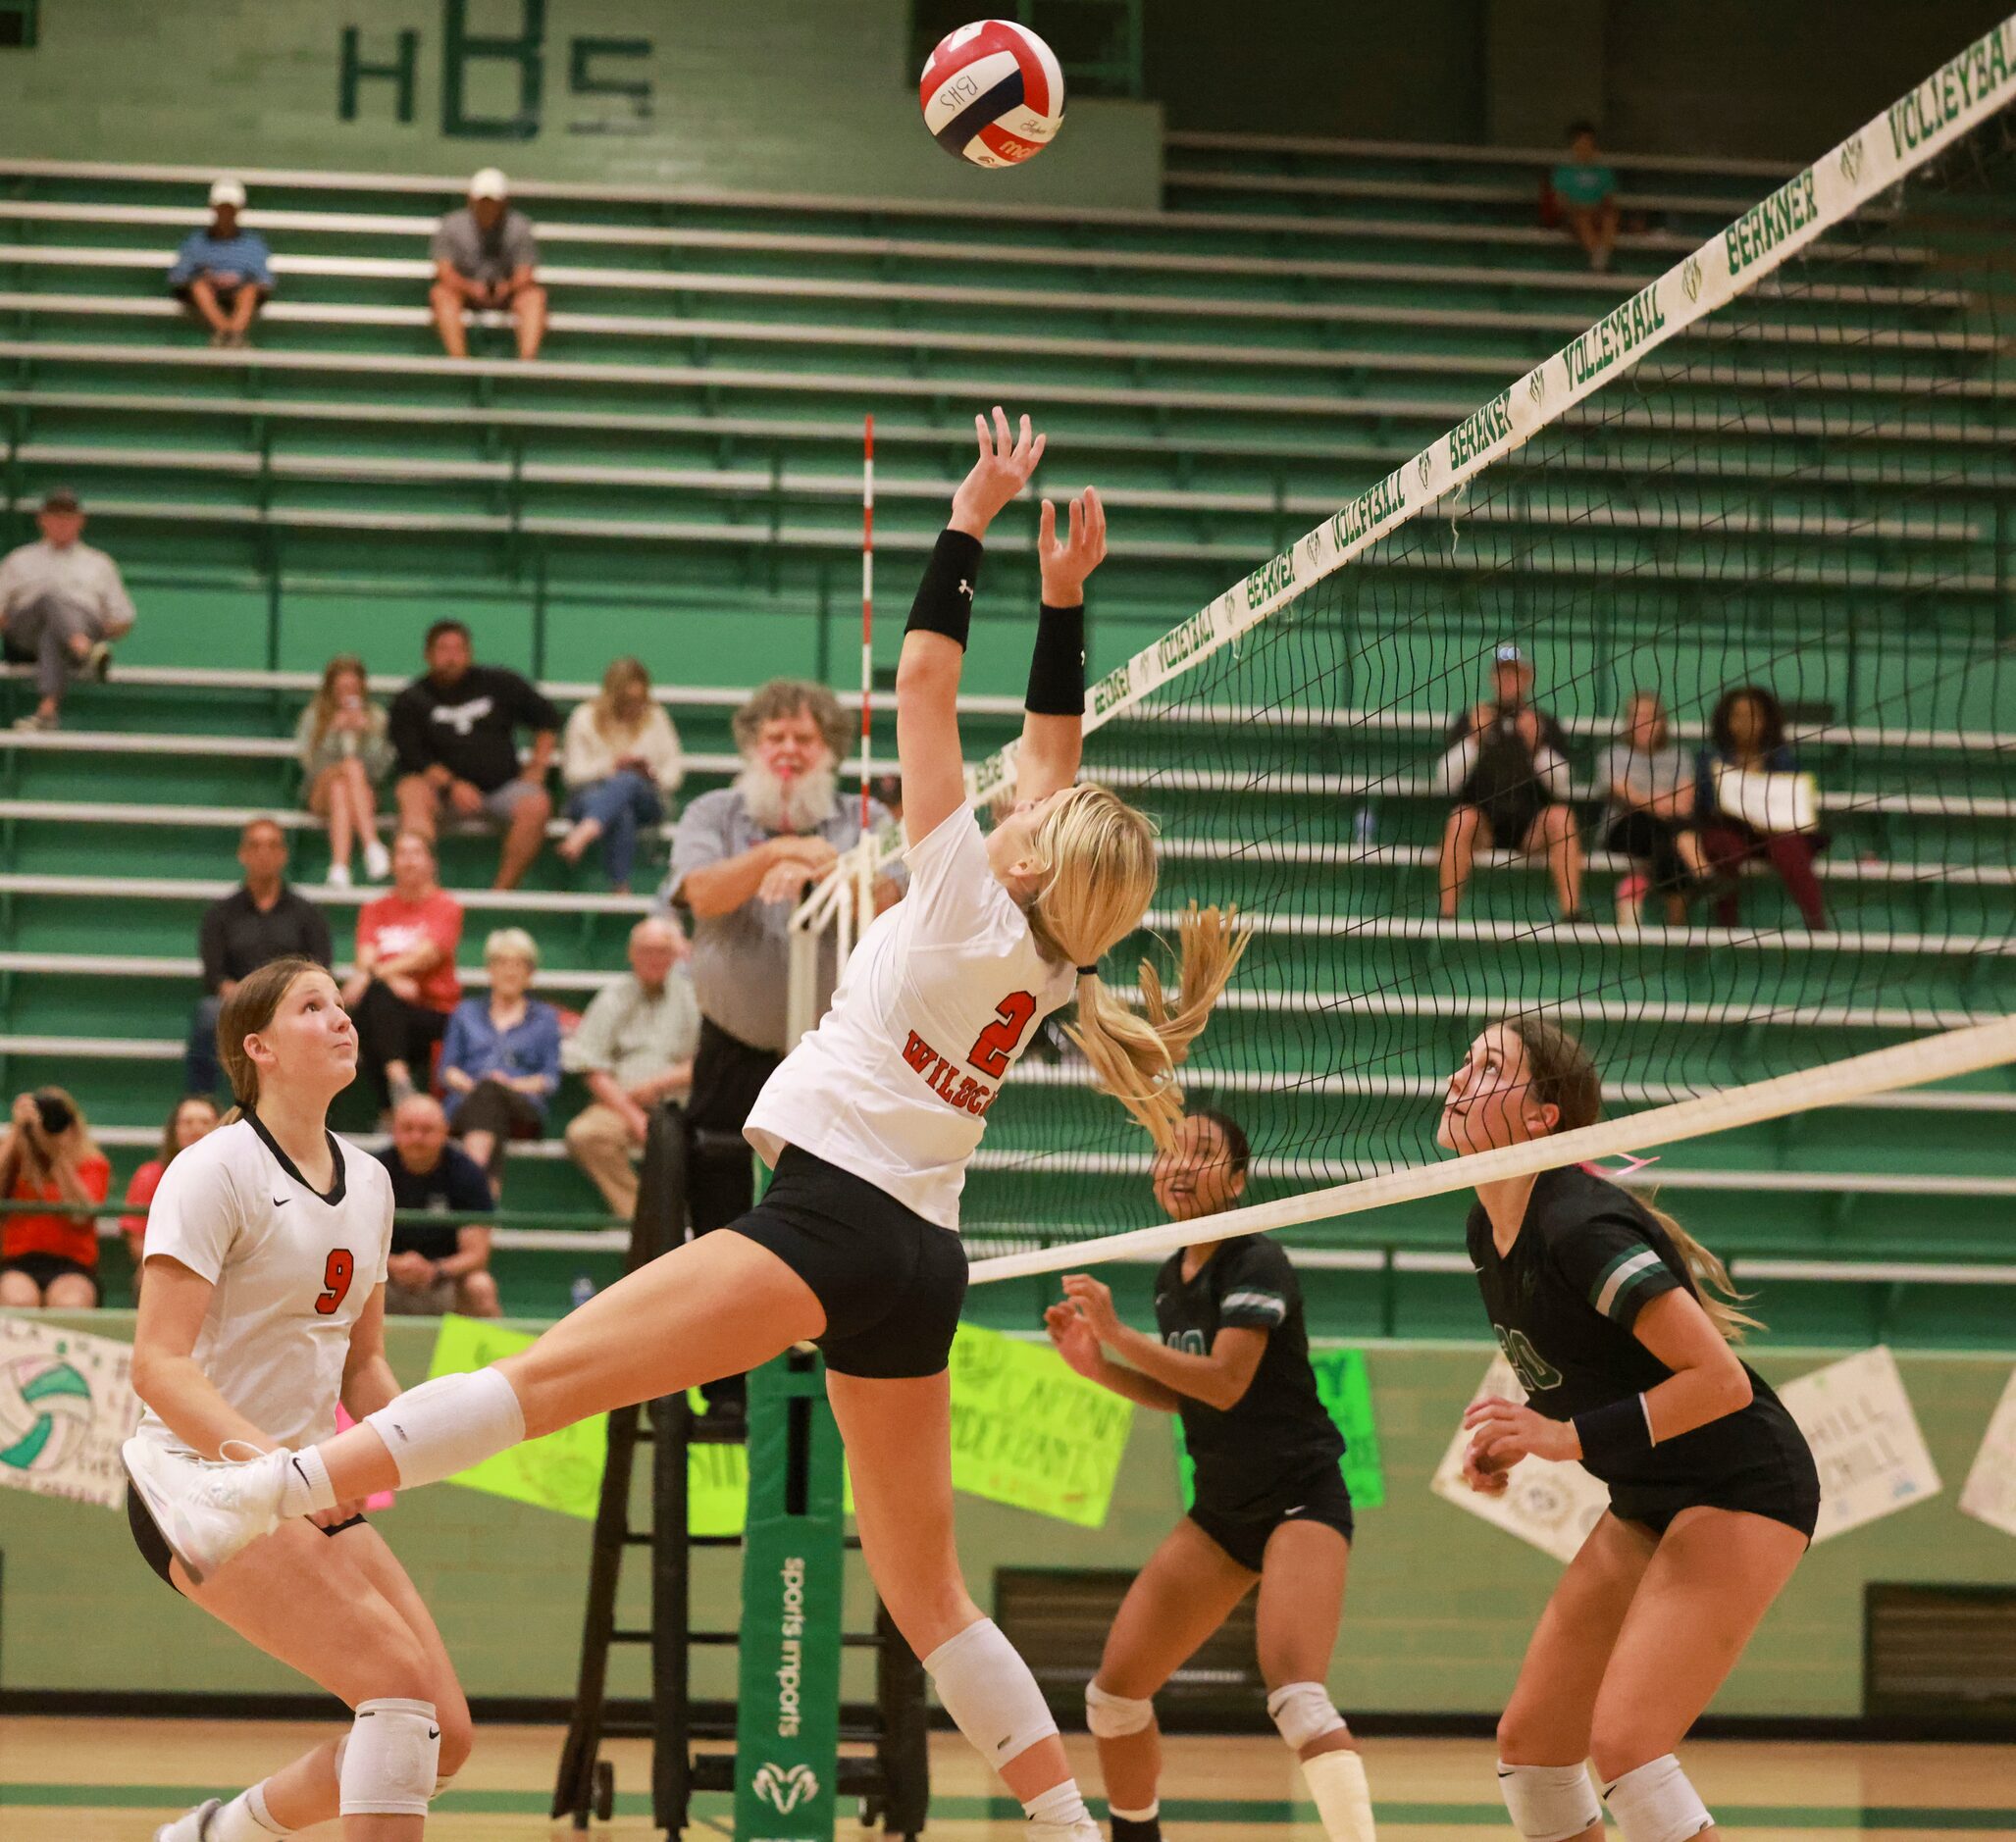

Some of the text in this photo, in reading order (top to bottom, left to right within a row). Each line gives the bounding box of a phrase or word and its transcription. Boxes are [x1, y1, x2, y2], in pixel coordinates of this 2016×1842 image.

[1330, 467, 1406, 553] VOLLEYBALL
[1448, 387, 1514, 471] BERKNER
[1562, 282, 1665, 392] VOLLEYBALL
[1725, 169, 1818, 276] BERKNER
[966, 991, 1036, 1079] 2
[315, 1249, 354, 1314] 9
